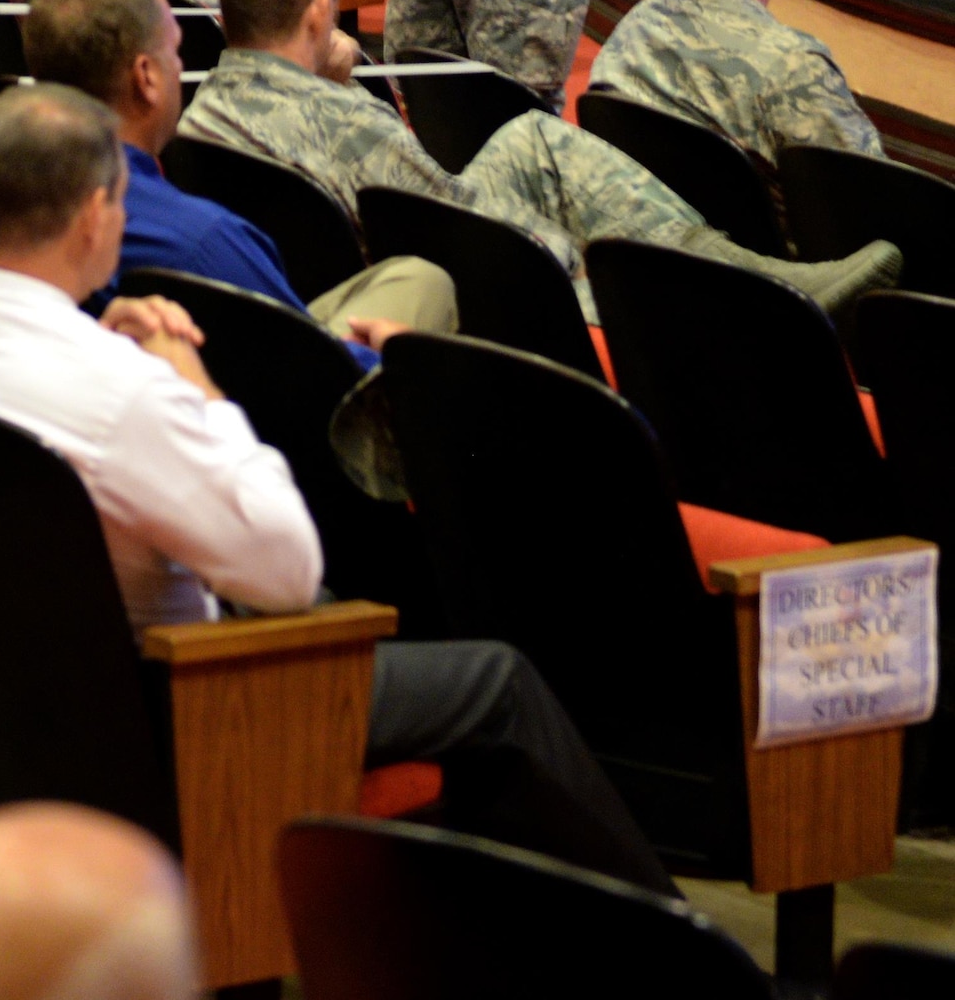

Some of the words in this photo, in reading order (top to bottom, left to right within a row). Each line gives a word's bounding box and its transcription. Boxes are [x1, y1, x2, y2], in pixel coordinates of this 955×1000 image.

[787, 614, 871, 650] CHIEFS
[876, 609, 907, 638] OF
[799, 652, 898, 686] SPECIAL
[811, 694, 881, 724] STAFF
